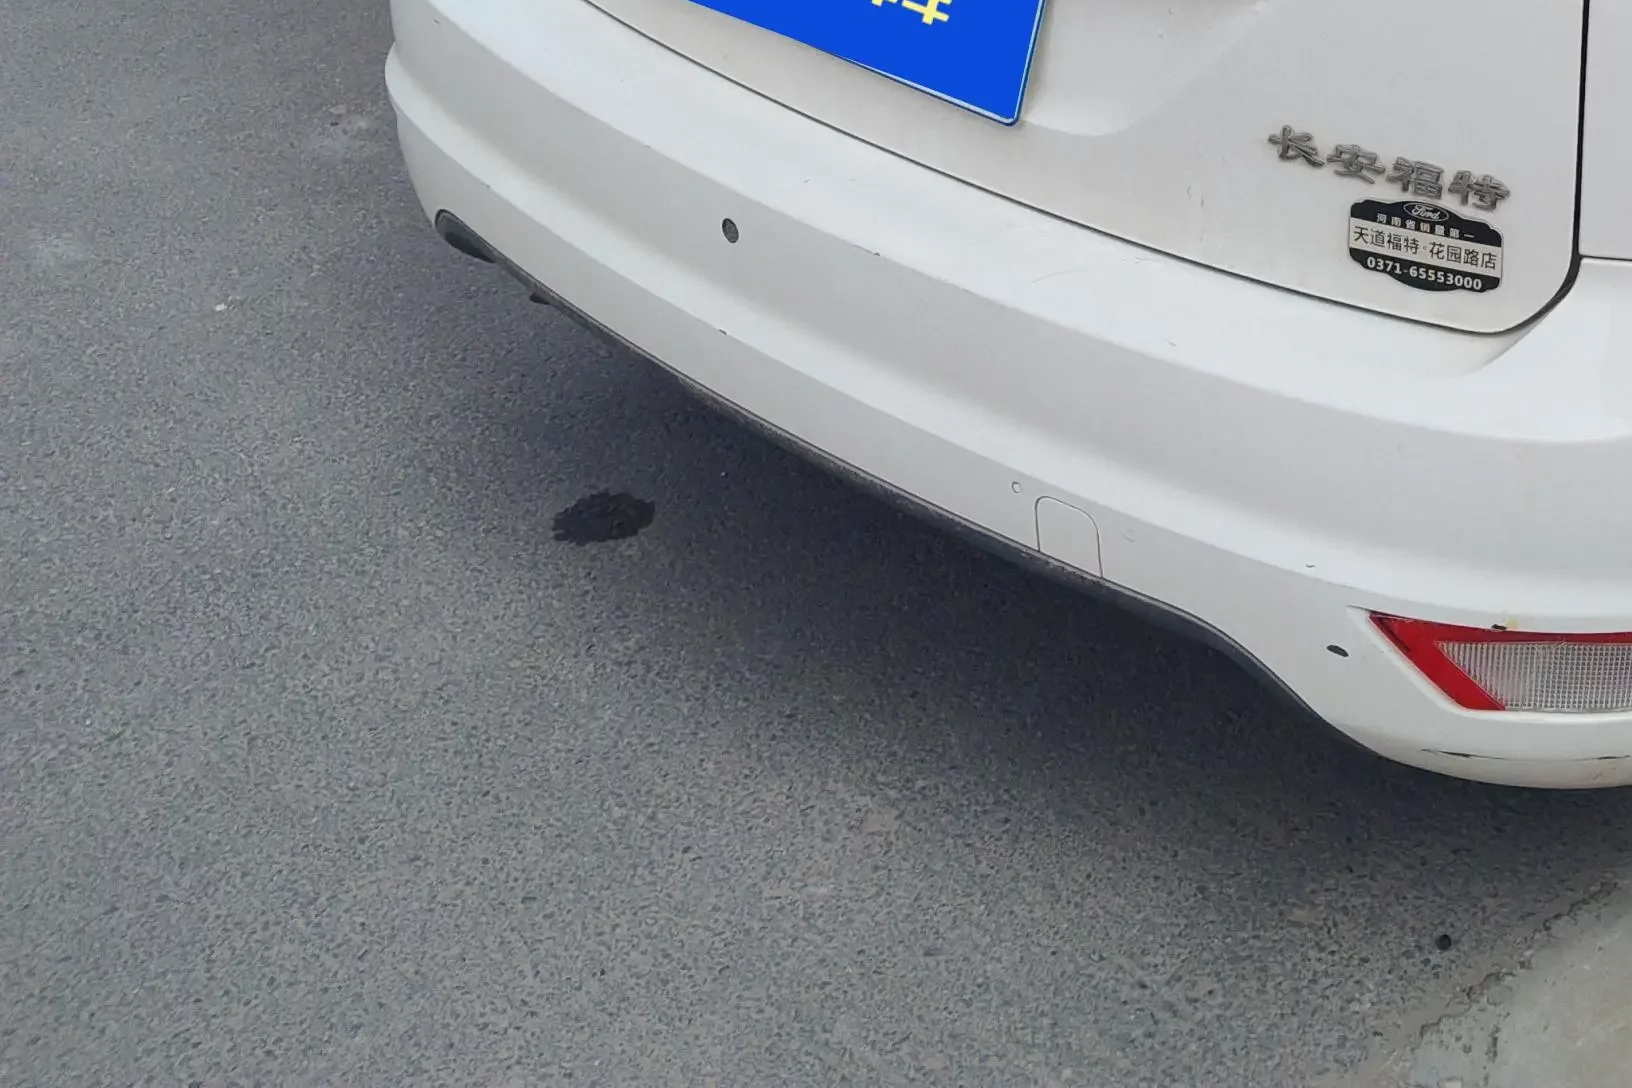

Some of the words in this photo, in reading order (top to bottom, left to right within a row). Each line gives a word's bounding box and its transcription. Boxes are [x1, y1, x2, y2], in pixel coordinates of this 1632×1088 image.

[1268, 124, 1511, 211] 长安福特
[1366, 257, 1482, 290] 0371-65553000
